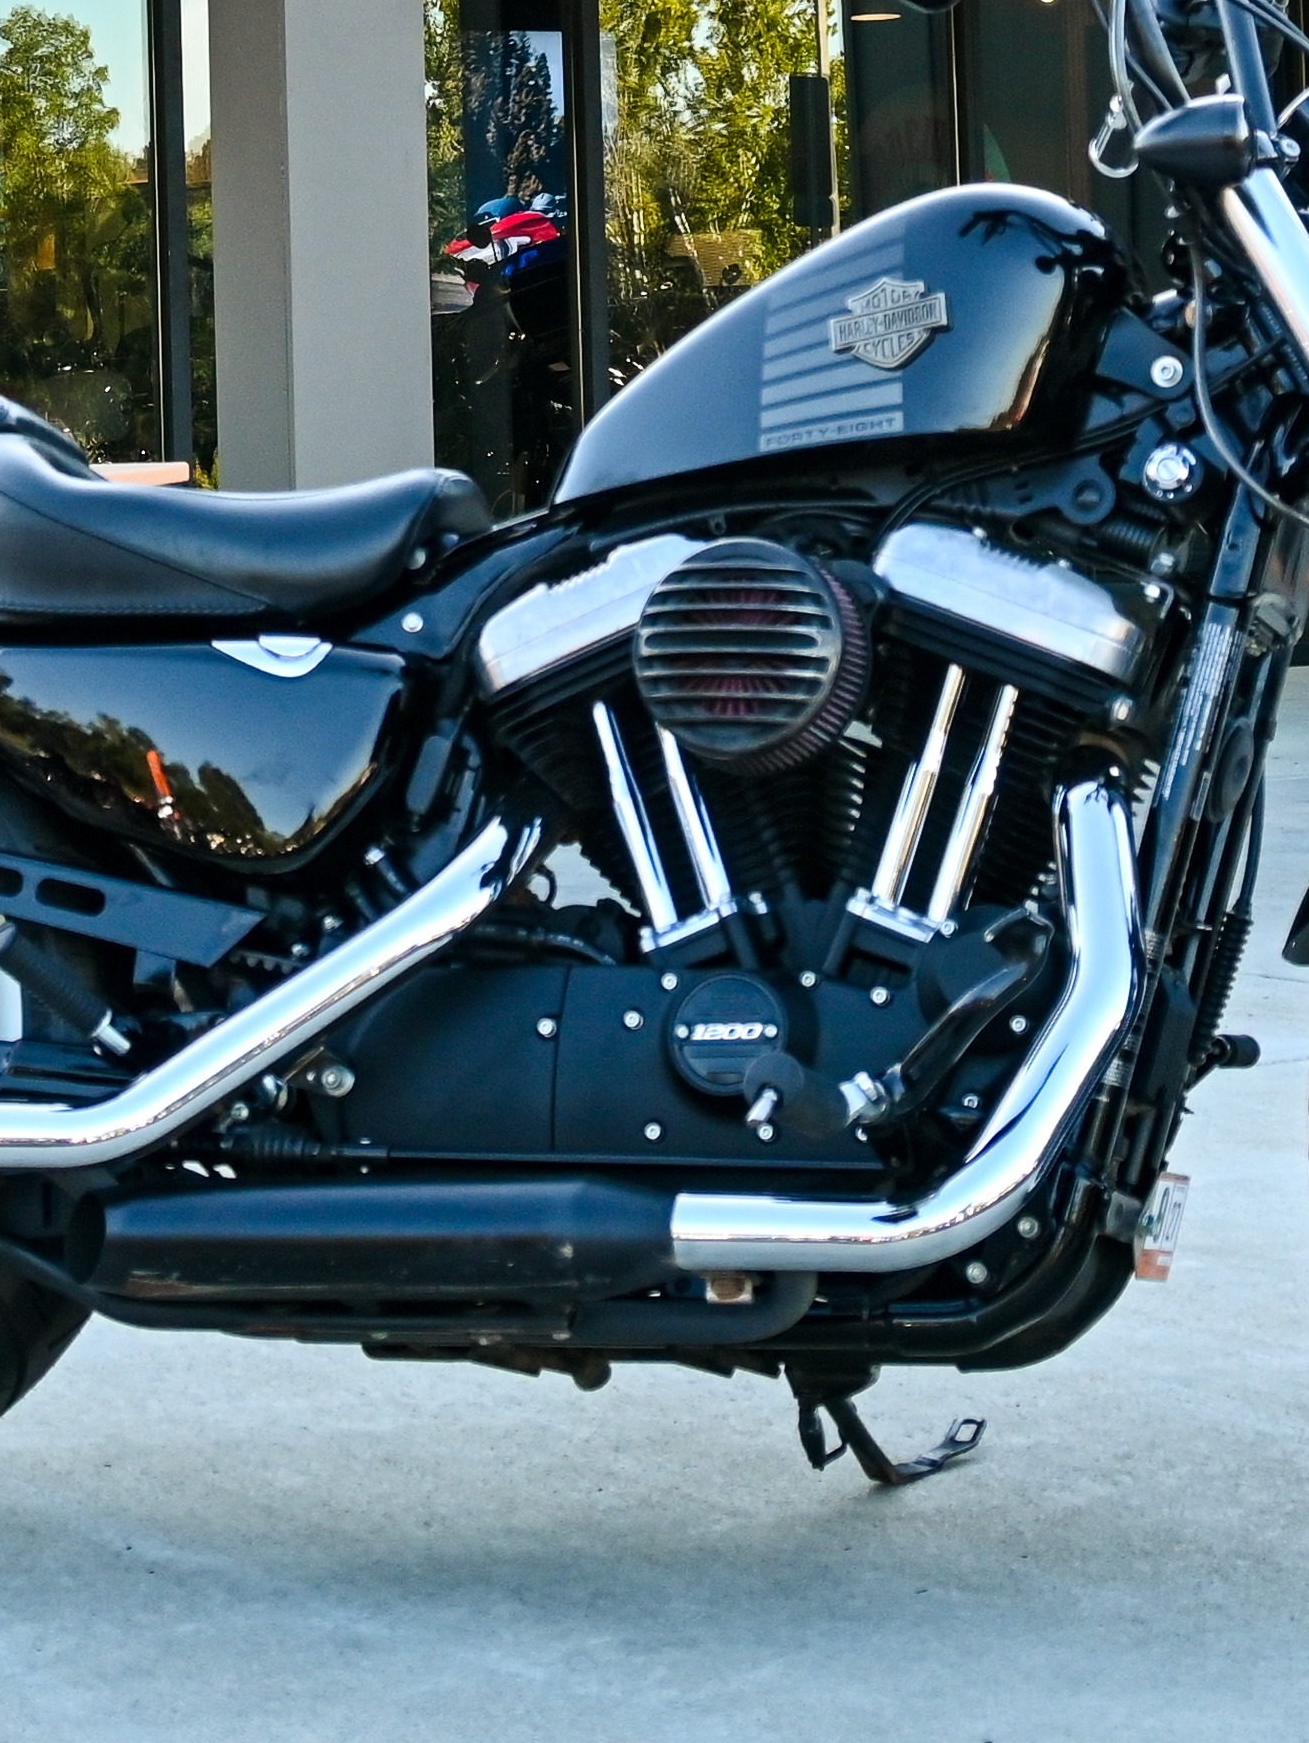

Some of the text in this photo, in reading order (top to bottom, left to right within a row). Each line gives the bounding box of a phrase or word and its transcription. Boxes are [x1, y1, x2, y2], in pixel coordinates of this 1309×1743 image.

[838, 301, 939, 341] HARLEY-DAVIDSON
[863, 332, 915, 359] CYCLES
[765, 417, 897, 448] FORTY-EIGHT
[691, 1021, 764, 1041] 1200
